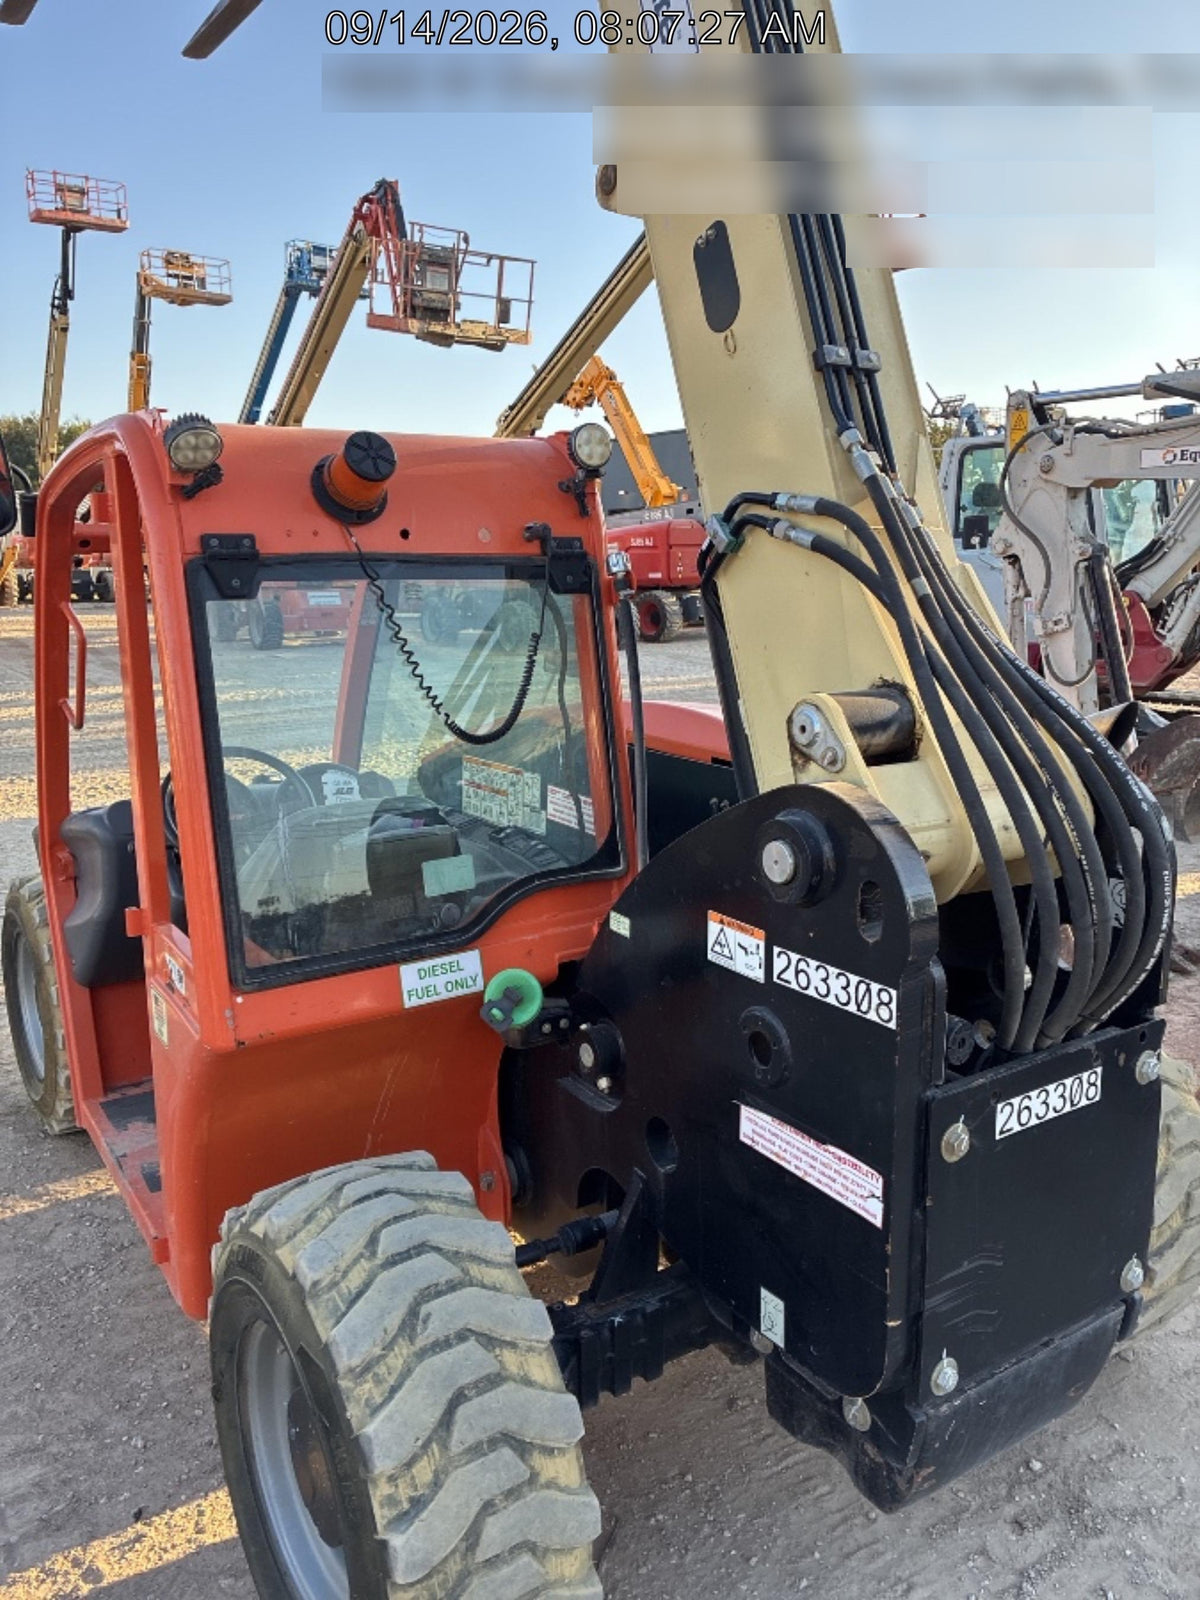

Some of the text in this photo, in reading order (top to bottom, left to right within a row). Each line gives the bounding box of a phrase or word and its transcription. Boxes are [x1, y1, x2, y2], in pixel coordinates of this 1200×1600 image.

[407, 973, 479, 1002] FUEL ONLY
[417, 959, 464, 980] DIESEL
[775, 949, 894, 1024] 263308
[998, 1070, 1099, 1136] 263308
